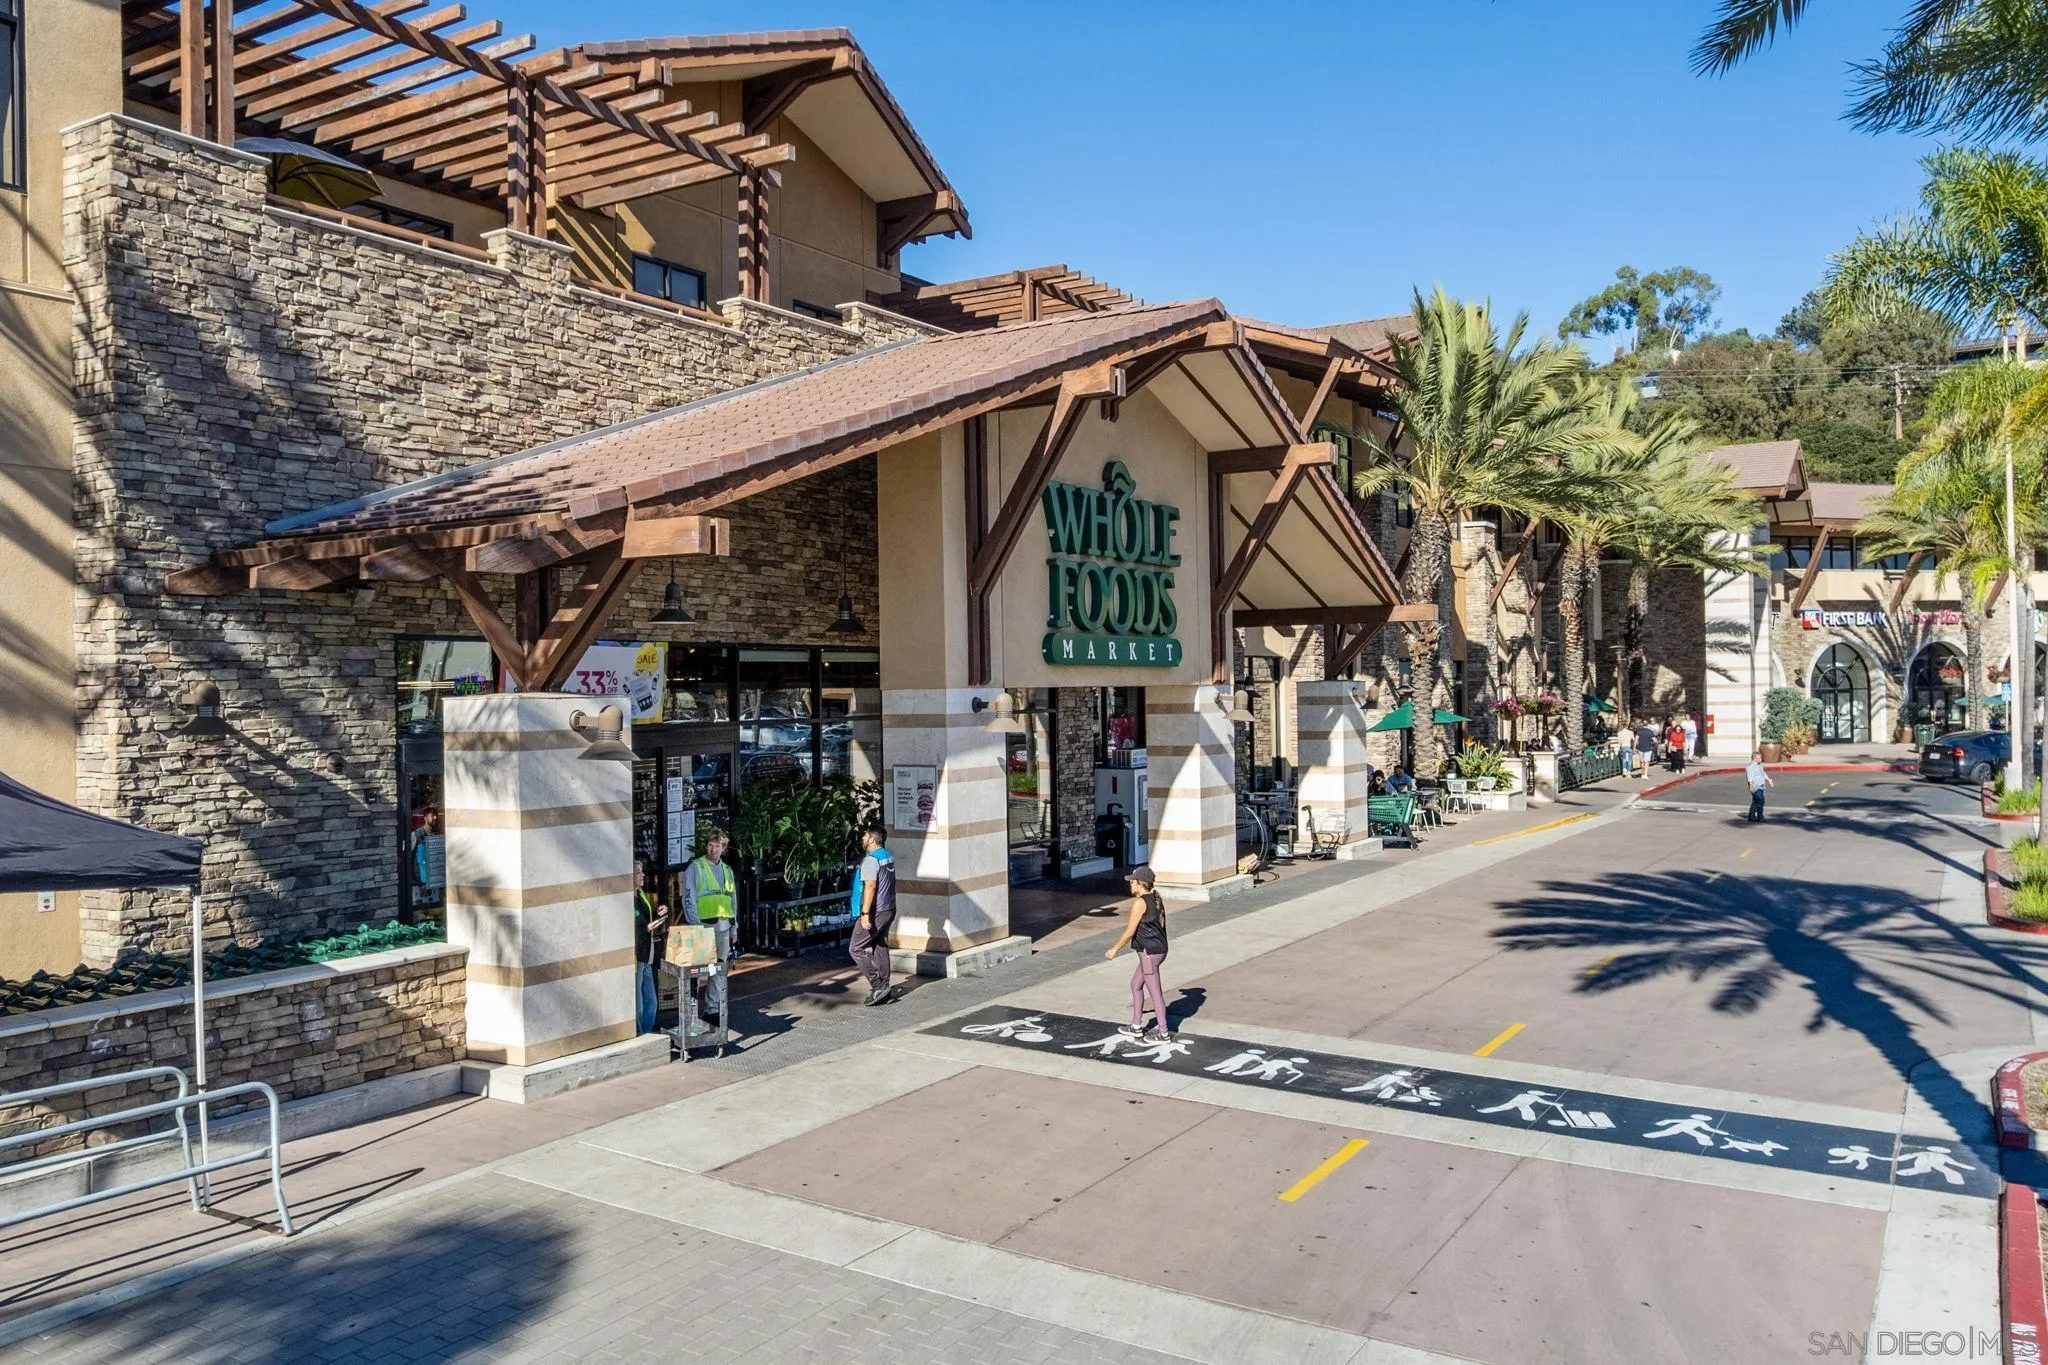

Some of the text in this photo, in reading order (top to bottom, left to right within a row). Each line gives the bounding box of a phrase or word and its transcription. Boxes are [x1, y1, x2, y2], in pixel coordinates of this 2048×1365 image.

[1043, 478, 1182, 567] WHOLE
[1046, 558, 1178, 635] FOODS
[1822, 611, 1854, 627] FIRST
[1856, 611, 1888, 627] BANK
[636, 652, 658, 664] SALE
[1063, 639, 1174, 661] MARKET
